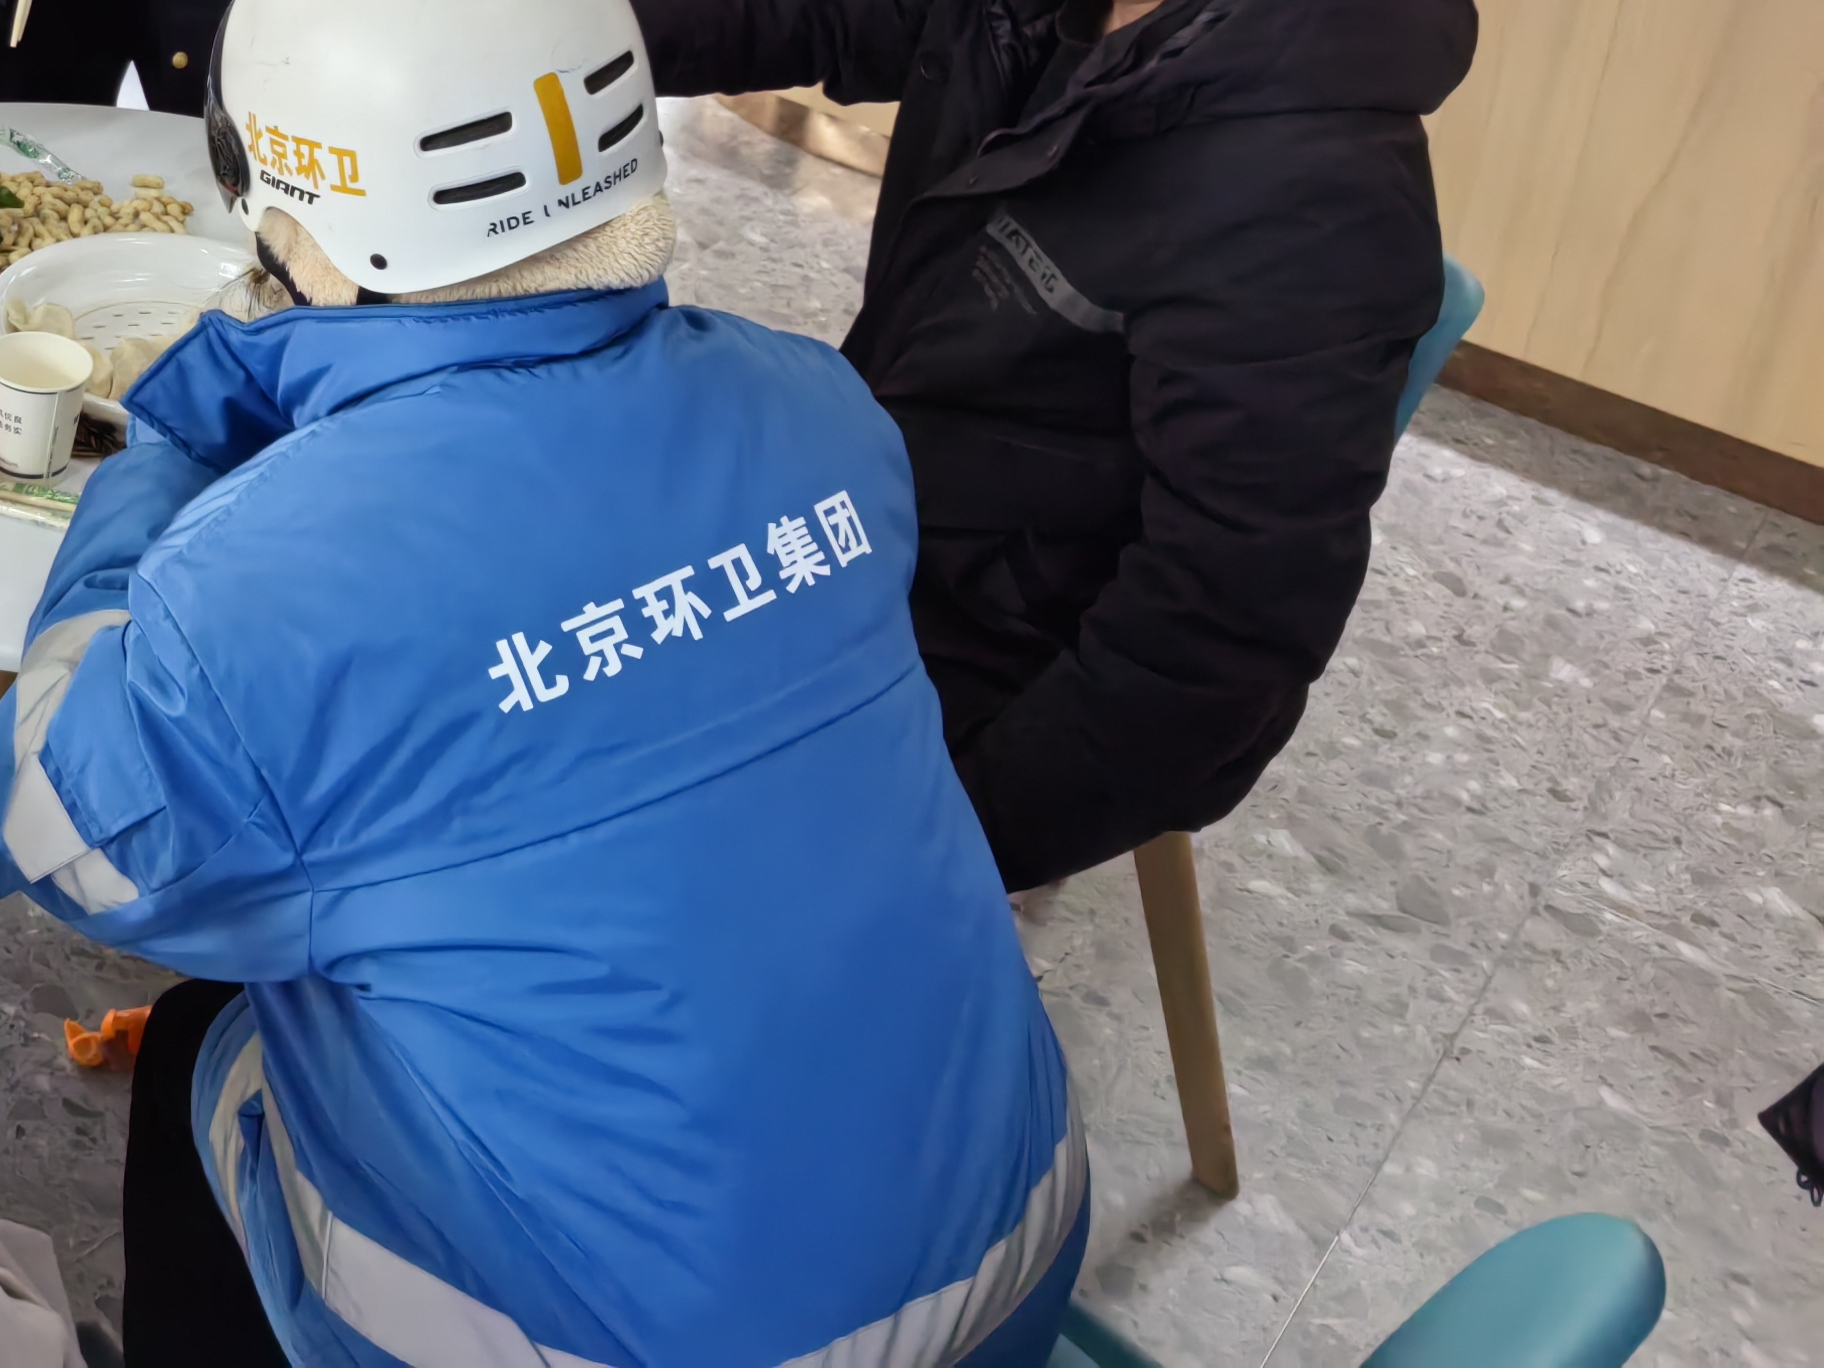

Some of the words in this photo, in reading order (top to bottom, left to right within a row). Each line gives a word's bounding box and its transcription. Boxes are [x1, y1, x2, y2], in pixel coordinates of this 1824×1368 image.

[245, 111, 367, 197] 北京环卫
[259, 169, 321, 206] GIANT
[487, 210, 535, 238] RIDE
[488, 490, 873, 713] 北京环卫集团
